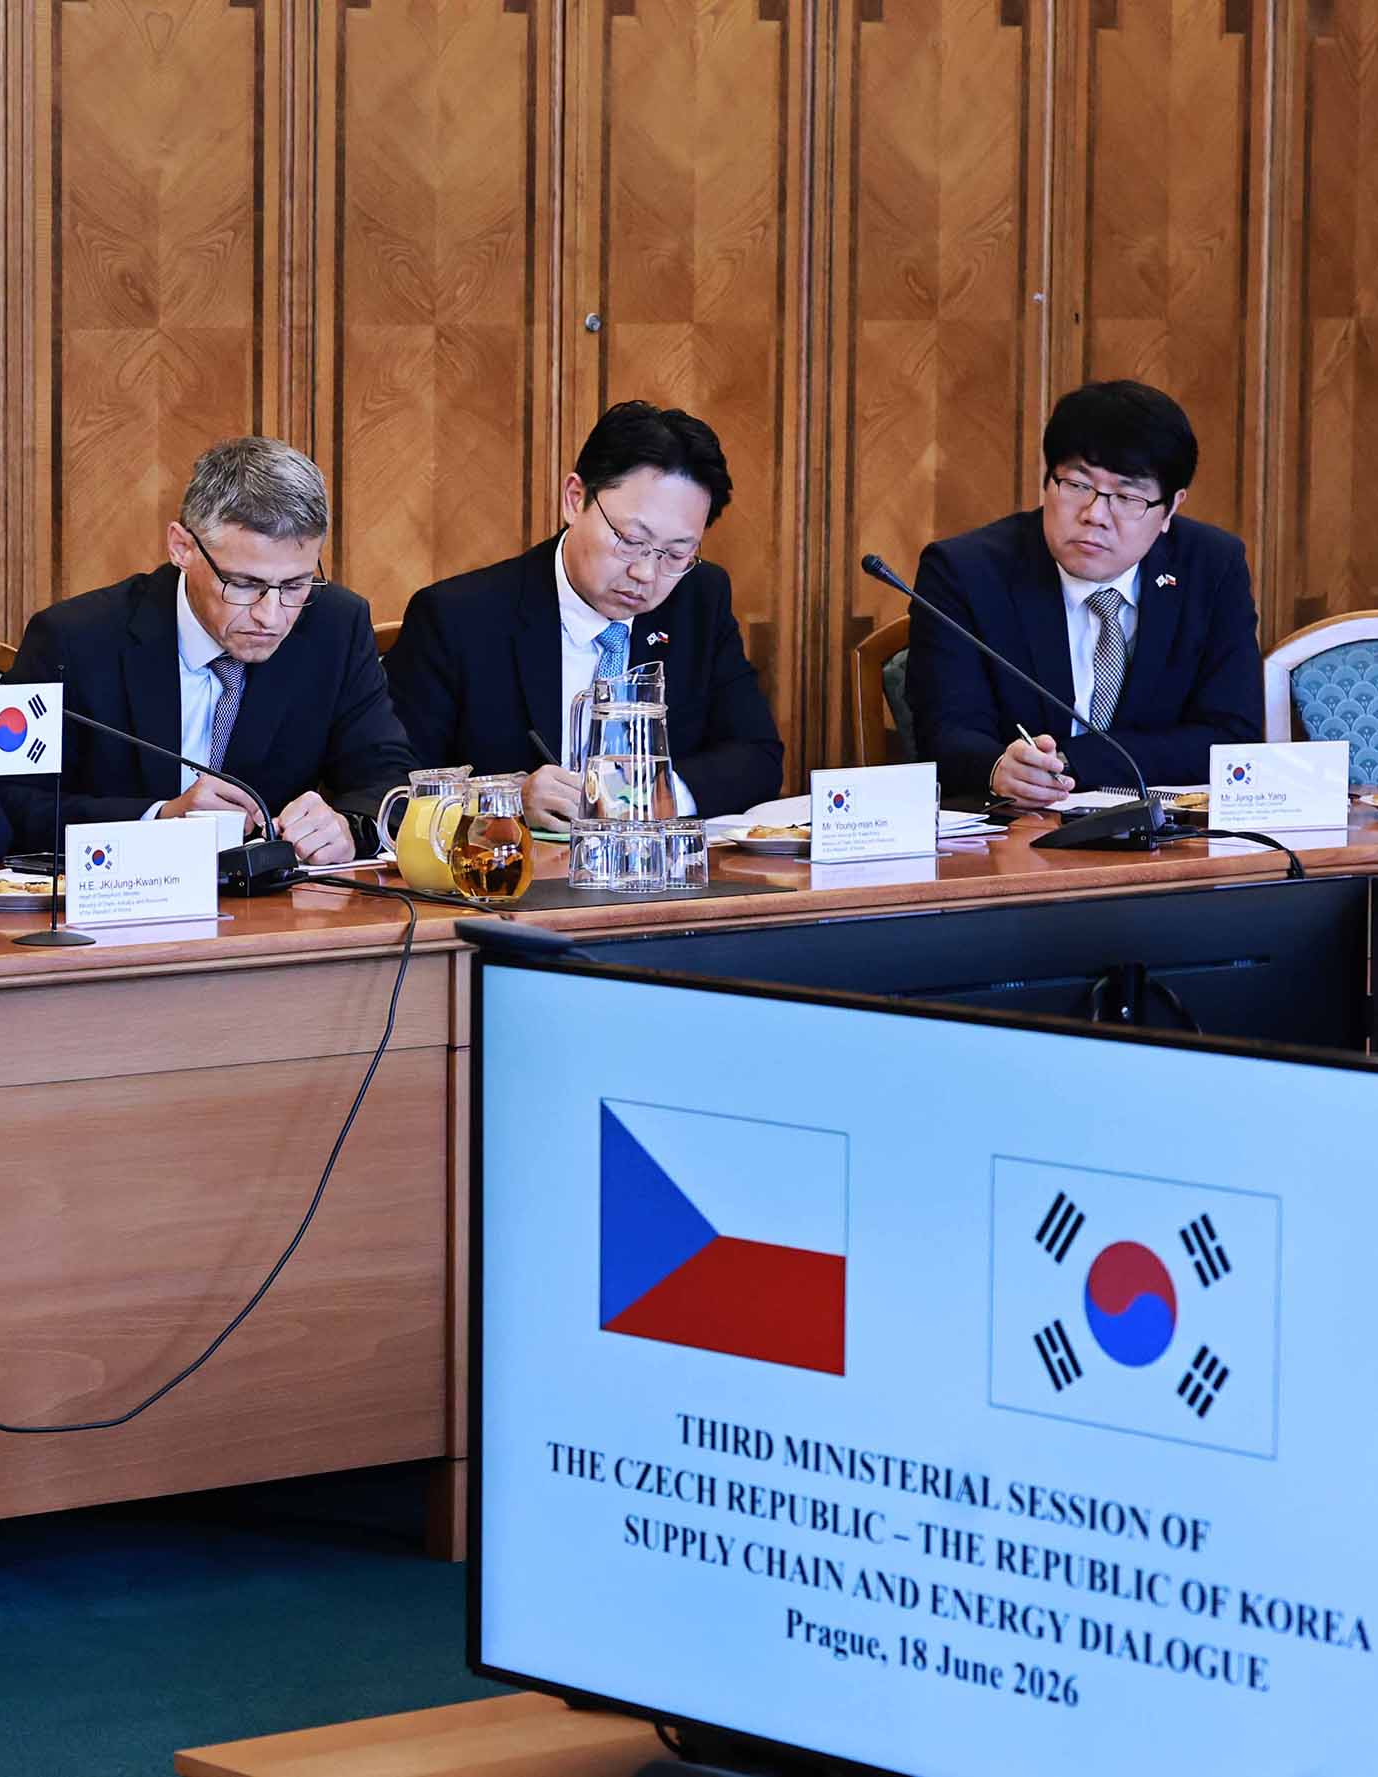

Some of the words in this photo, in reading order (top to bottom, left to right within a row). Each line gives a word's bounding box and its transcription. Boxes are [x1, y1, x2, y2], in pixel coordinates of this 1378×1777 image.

[1267, 791, 1287, 802] Yang
[79, 880, 97, 891] H.E.
[99, 876, 162, 890] JK(Jung-Kwan)
[163, 875, 180, 886] Kim
[677, 1412, 775, 1462] THIRD
[783, 1434, 1000, 1511] MINISTERIAL
[1008, 1481, 1152, 1542] SESSION
[1161, 1512, 1211, 1553] OF
[546, 1440, 606, 1484] THE
[613, 1456, 718, 1508] CZECH
[727, 1478, 887, 1545] REPUBLIC
[917, 1522, 986, 1568] THE
[995, 1538, 1172, 1608] REPUBLIC
[1179, 1578, 1231, 1620] OF
[1239, 1590, 1373, 1653] KOREA
[624, 1513, 737, 1568] SUPPLY
[742, 1540, 846, 1592] CHAIN
[851, 1568, 921, 1611] AND
[930, 1582, 1071, 1645] ENERGY
[1079, 1617, 1271, 1694] DIALOGUE
[786, 1607, 888, 1663] Prague,
[898, 1636, 928, 1672] 18
[935, 1645, 1004, 1690] June
[1012, 1661, 1080, 1708] 2026
